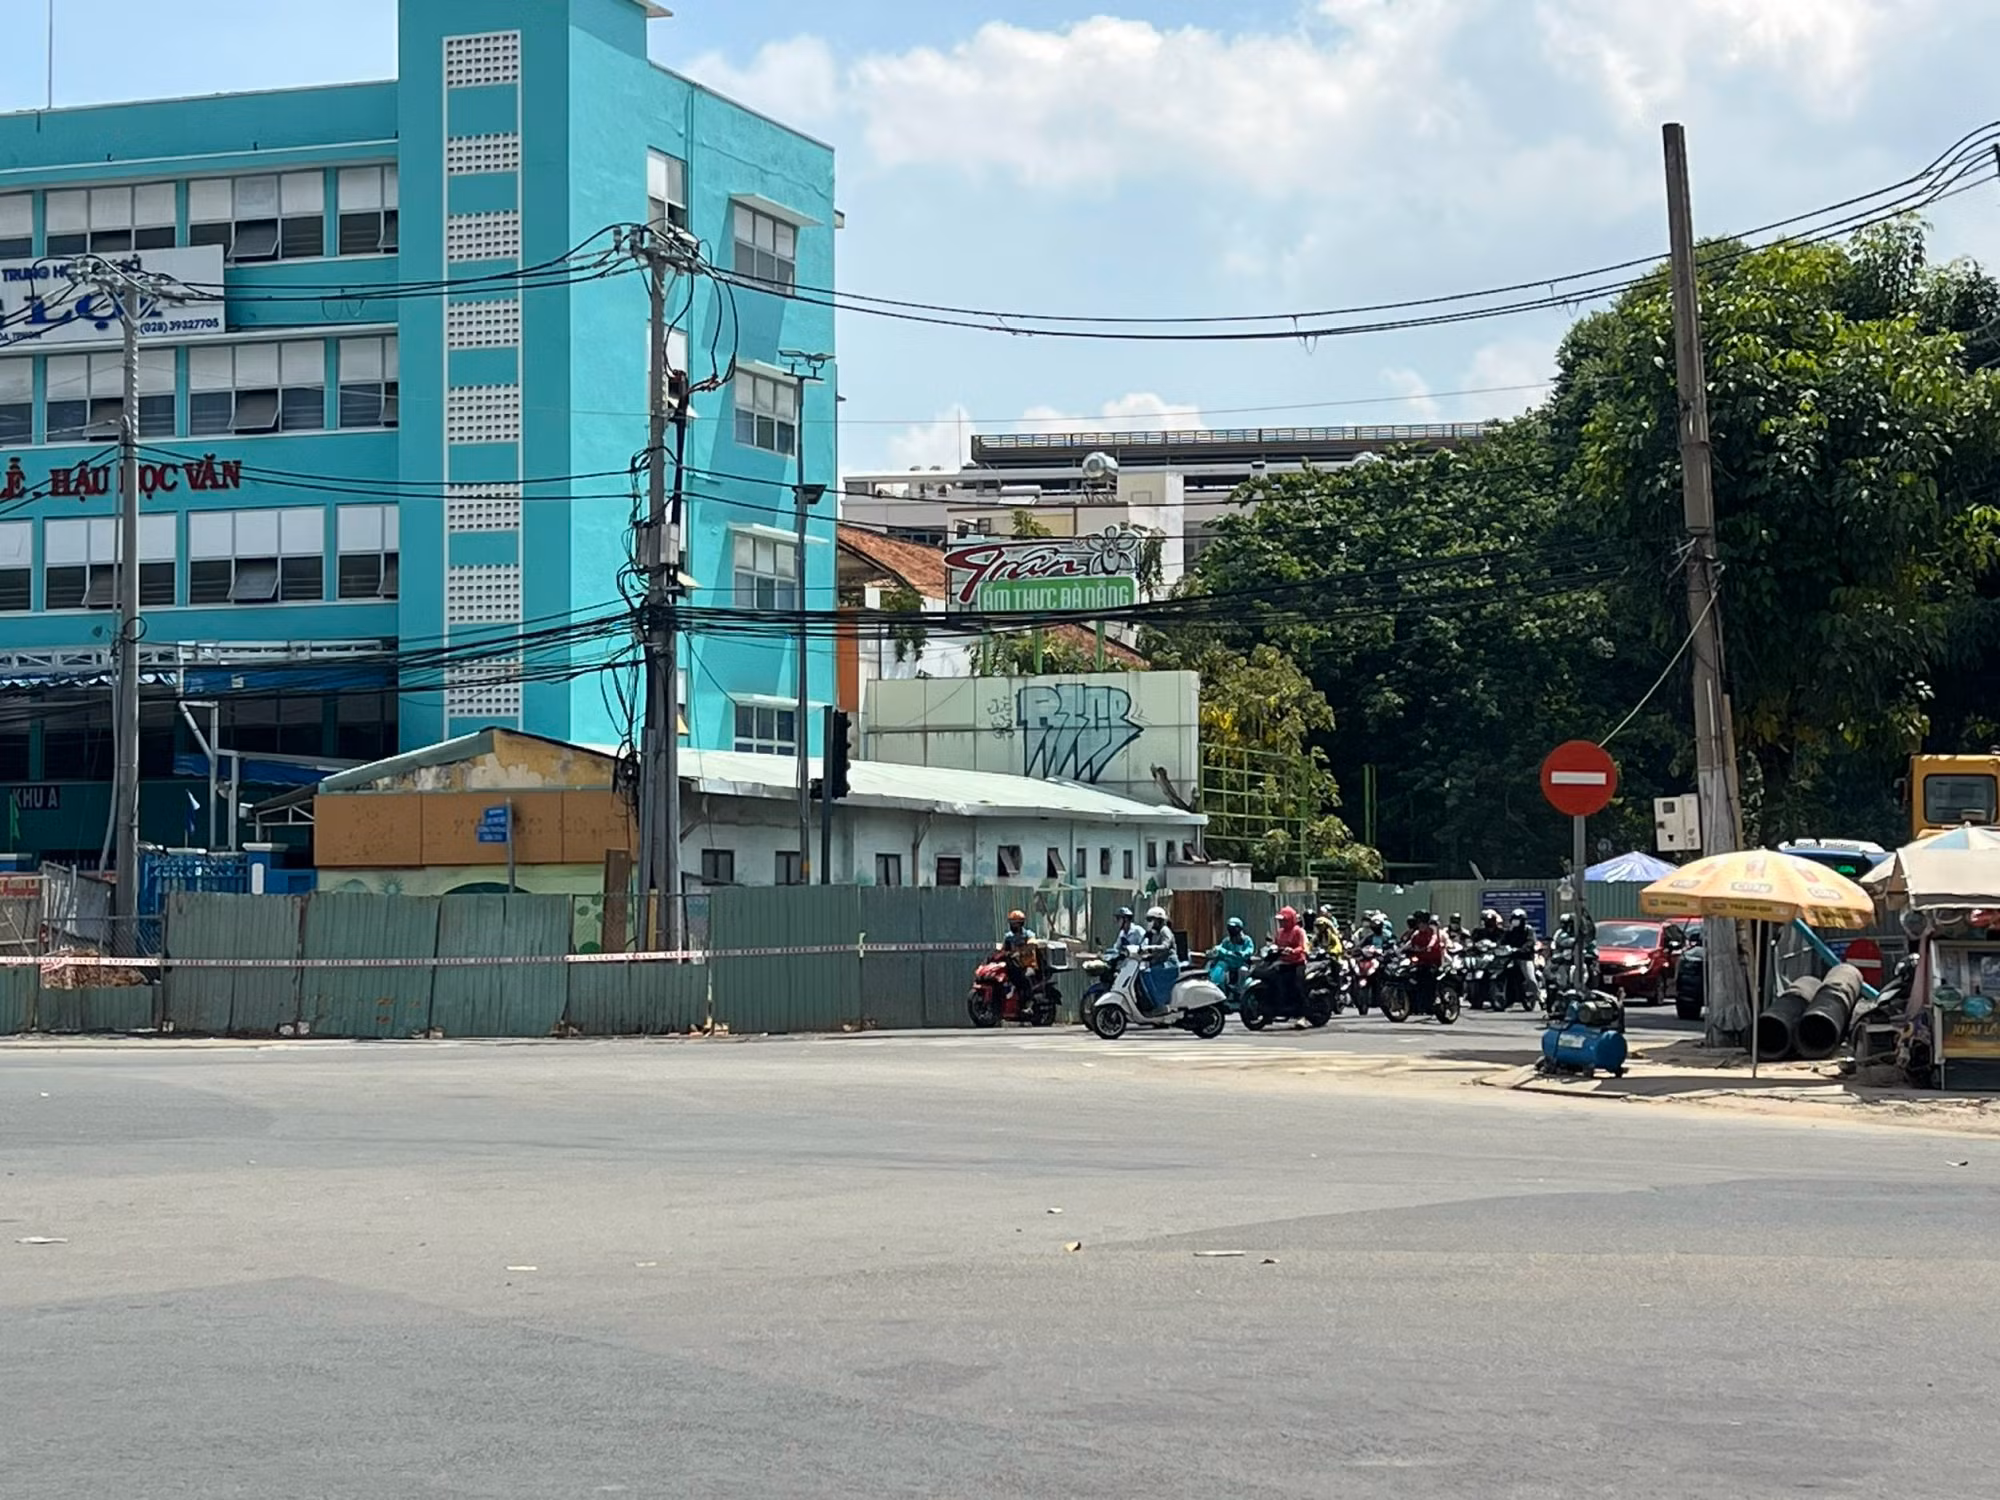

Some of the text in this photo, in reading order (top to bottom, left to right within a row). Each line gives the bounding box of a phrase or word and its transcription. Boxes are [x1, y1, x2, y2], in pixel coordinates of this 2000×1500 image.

[140, 321, 168, 335] (028)
[50, 459, 111, 503] HẬU
[182, 452, 242, 490] VĂN
[12, 786, 59, 809] KHU A
